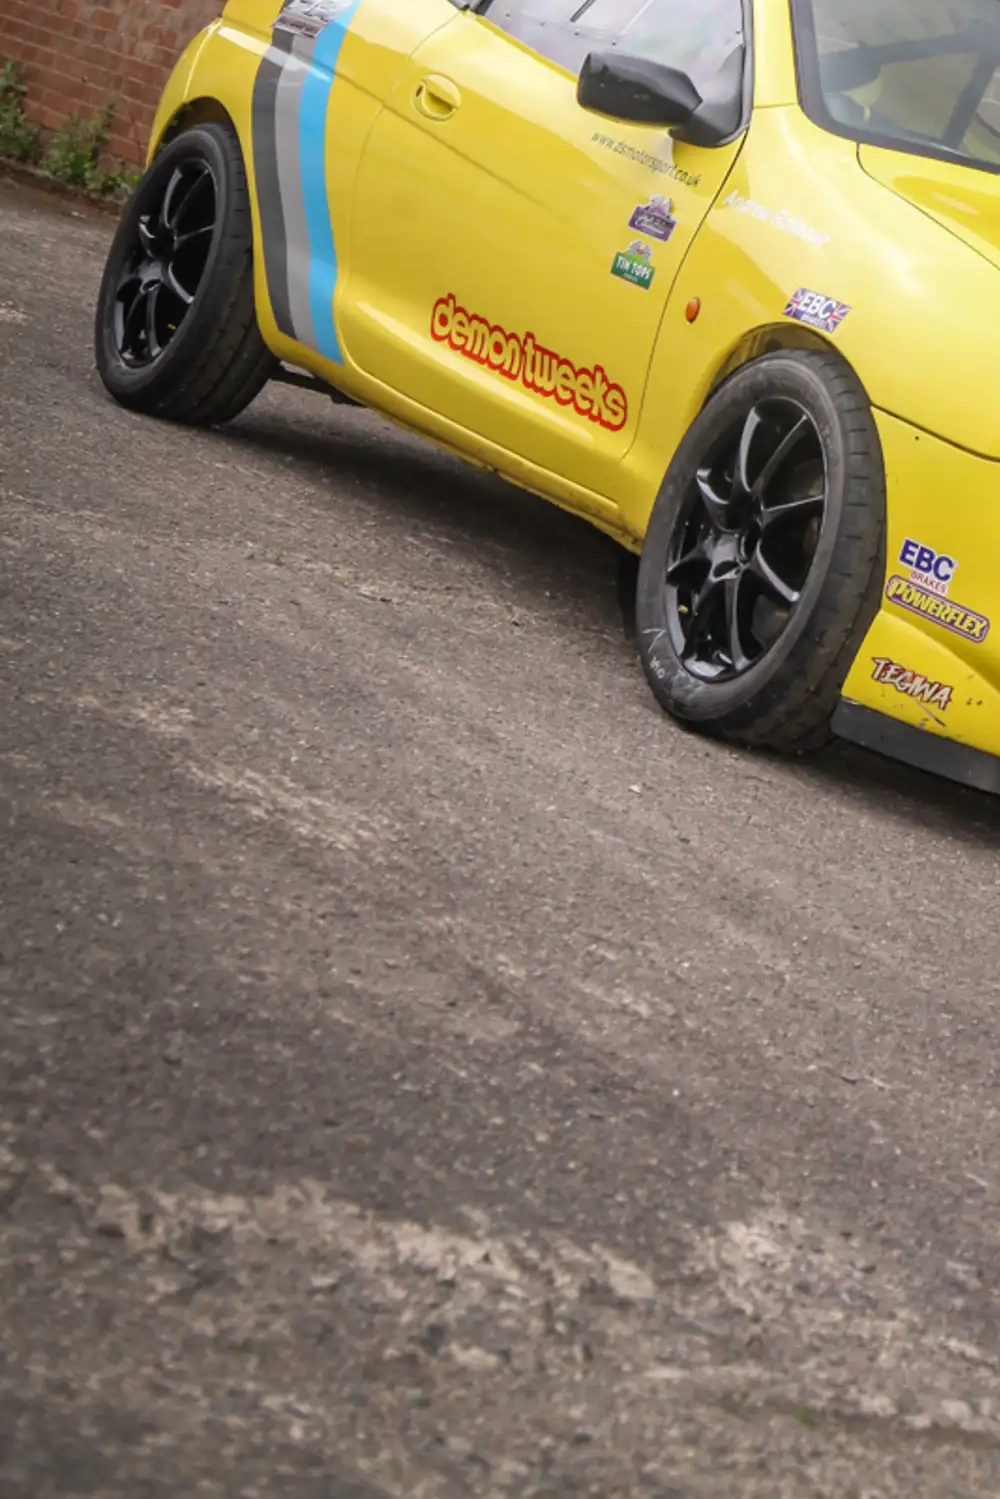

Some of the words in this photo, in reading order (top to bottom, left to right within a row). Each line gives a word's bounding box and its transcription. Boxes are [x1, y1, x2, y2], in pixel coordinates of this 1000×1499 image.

[615, 255, 630, 272] TIN
[799, 291, 837, 319] EBC
[431, 292, 522, 381] demon
[522, 331, 628, 432] tweeks
[899, 539, 955, 583] EBC
[911, 570, 948, 596] BRAKES
[887, 580, 988, 639] POWERFLEX
